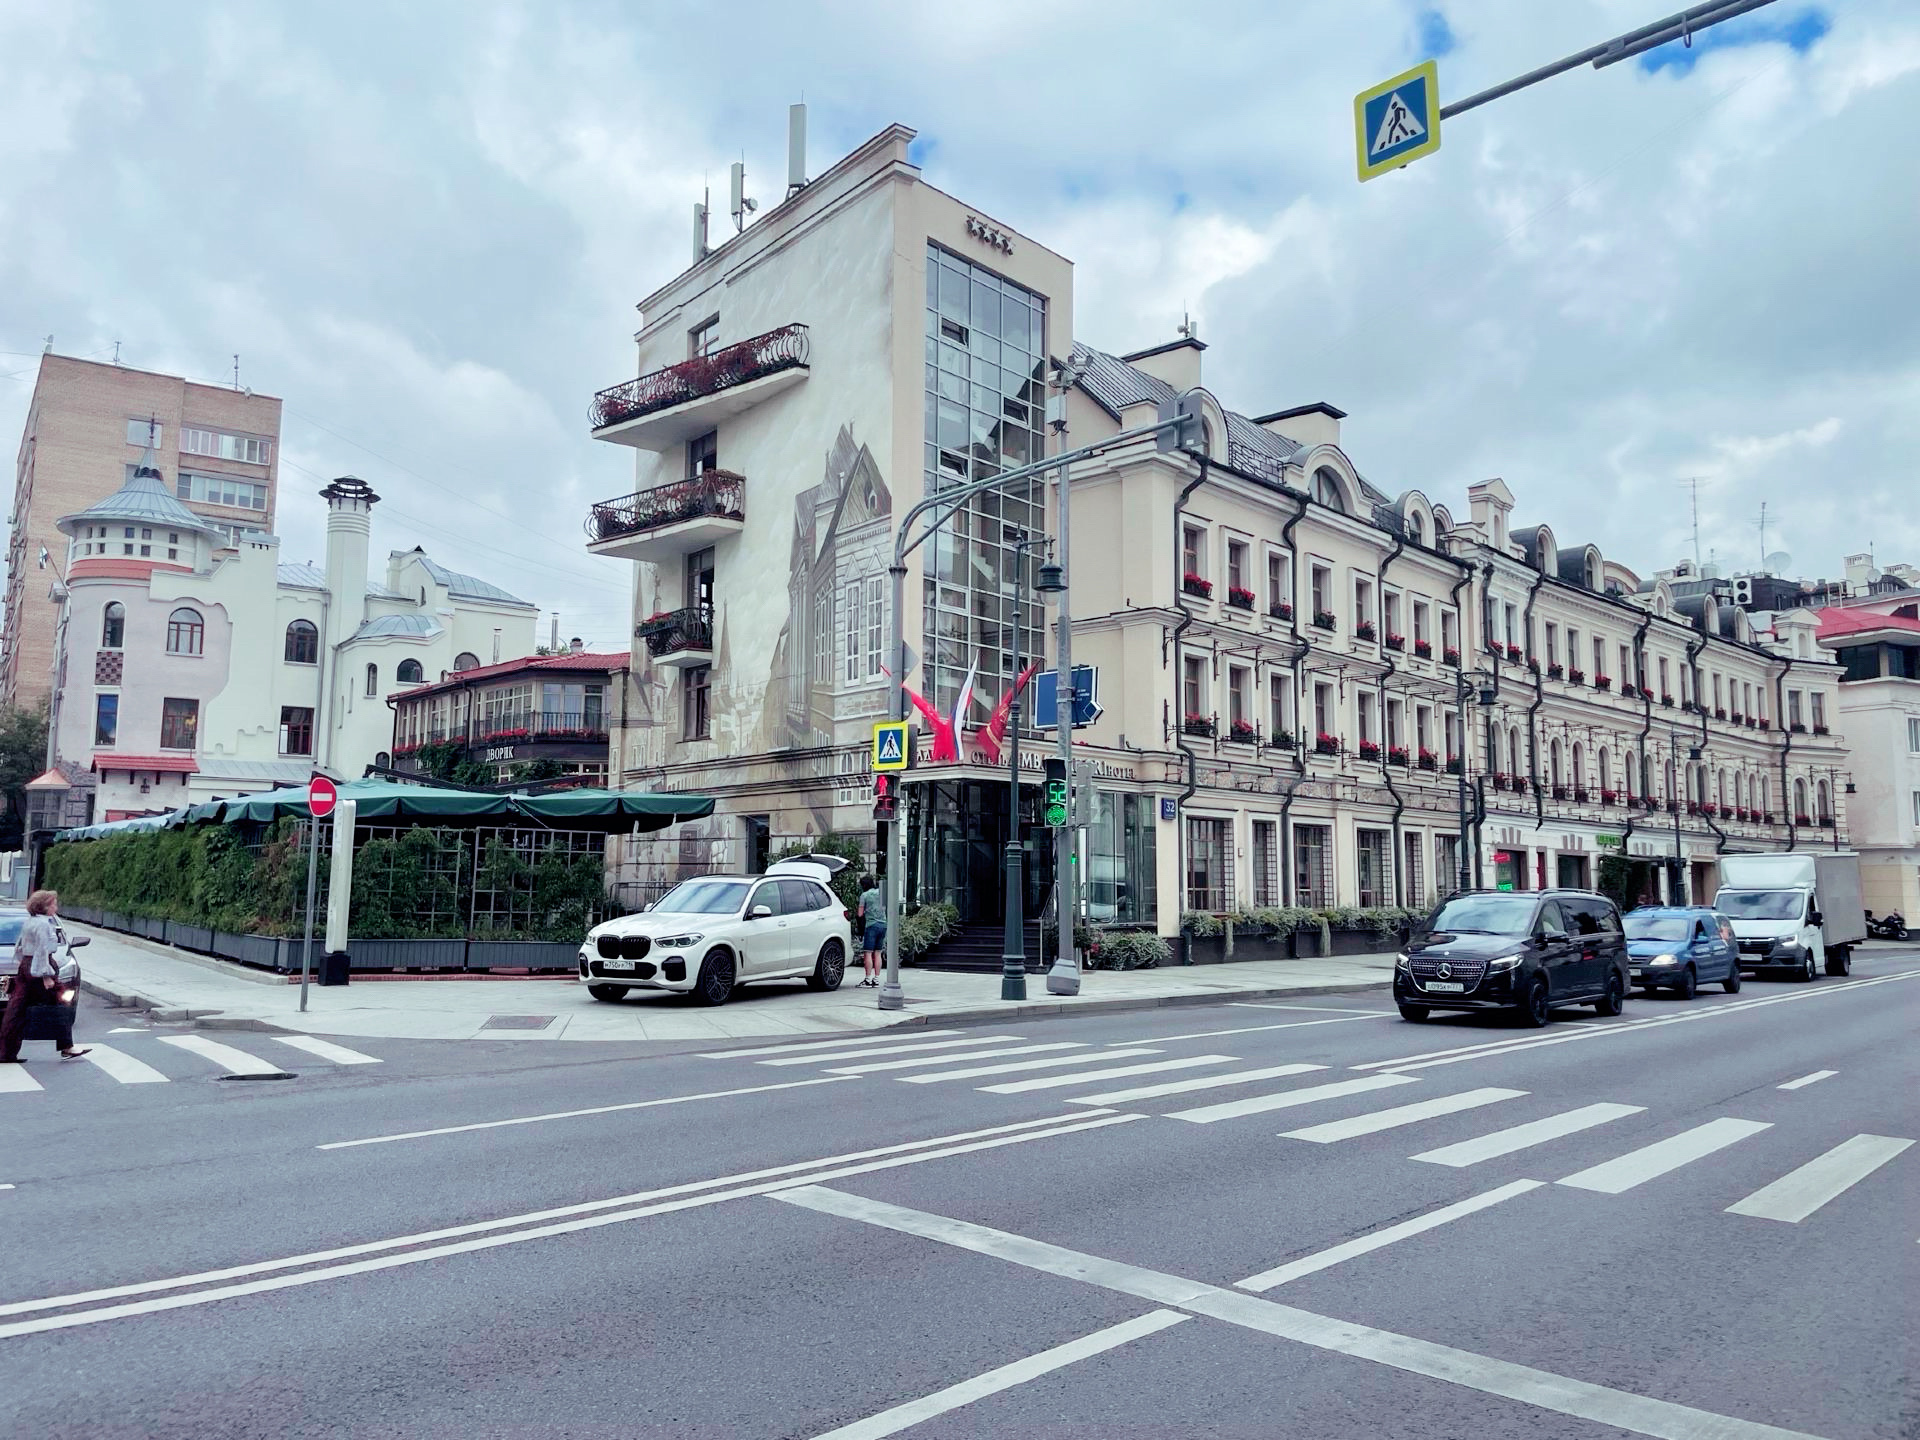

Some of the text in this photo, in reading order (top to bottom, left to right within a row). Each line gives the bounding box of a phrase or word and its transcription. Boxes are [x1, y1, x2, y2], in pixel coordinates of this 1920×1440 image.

[485, 746, 514, 763] ДВОРИК
[1105, 765, 1136, 779] HOTEL
[1049, 782, 1066, 802] 52
[1165, 801, 1175, 813] 32
